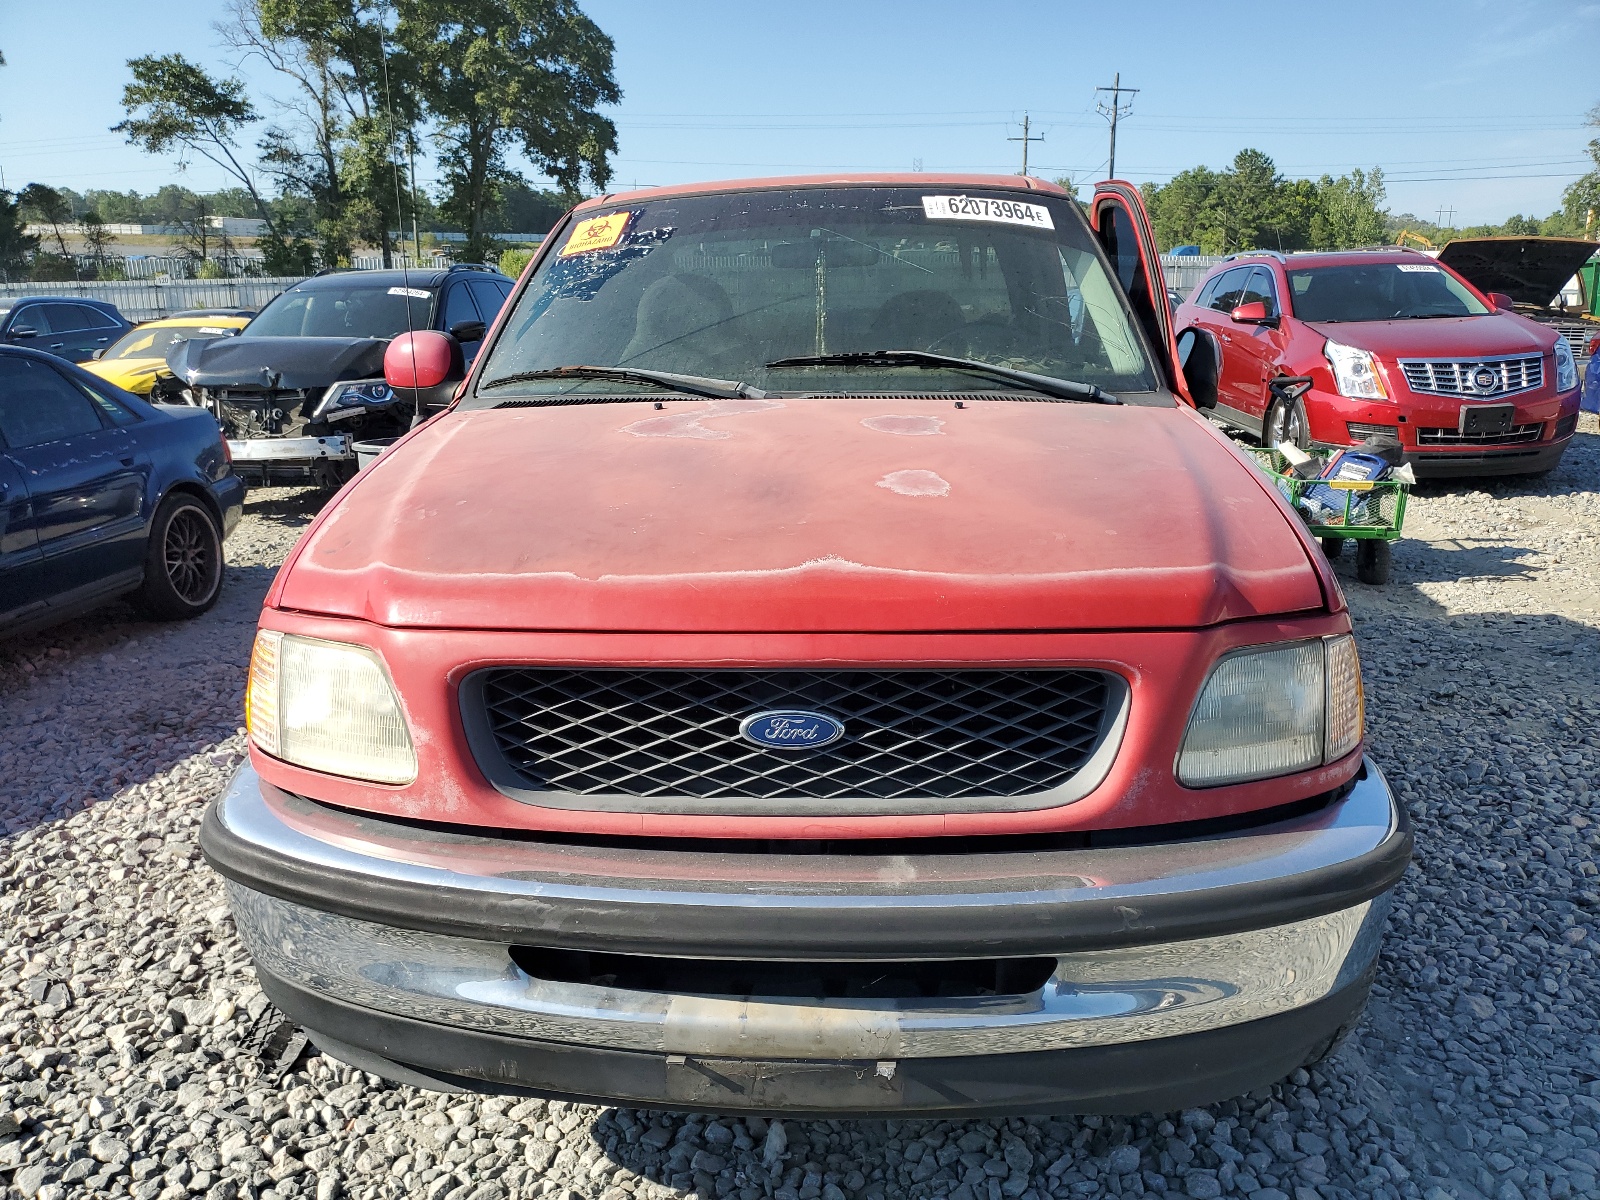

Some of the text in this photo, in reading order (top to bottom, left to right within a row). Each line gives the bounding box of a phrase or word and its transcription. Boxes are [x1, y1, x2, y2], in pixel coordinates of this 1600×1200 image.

[948, 197, 1036, 221] 62073964
[568, 236, 613, 251] BIOHAZARD
[764, 717, 820, 740] Ford
